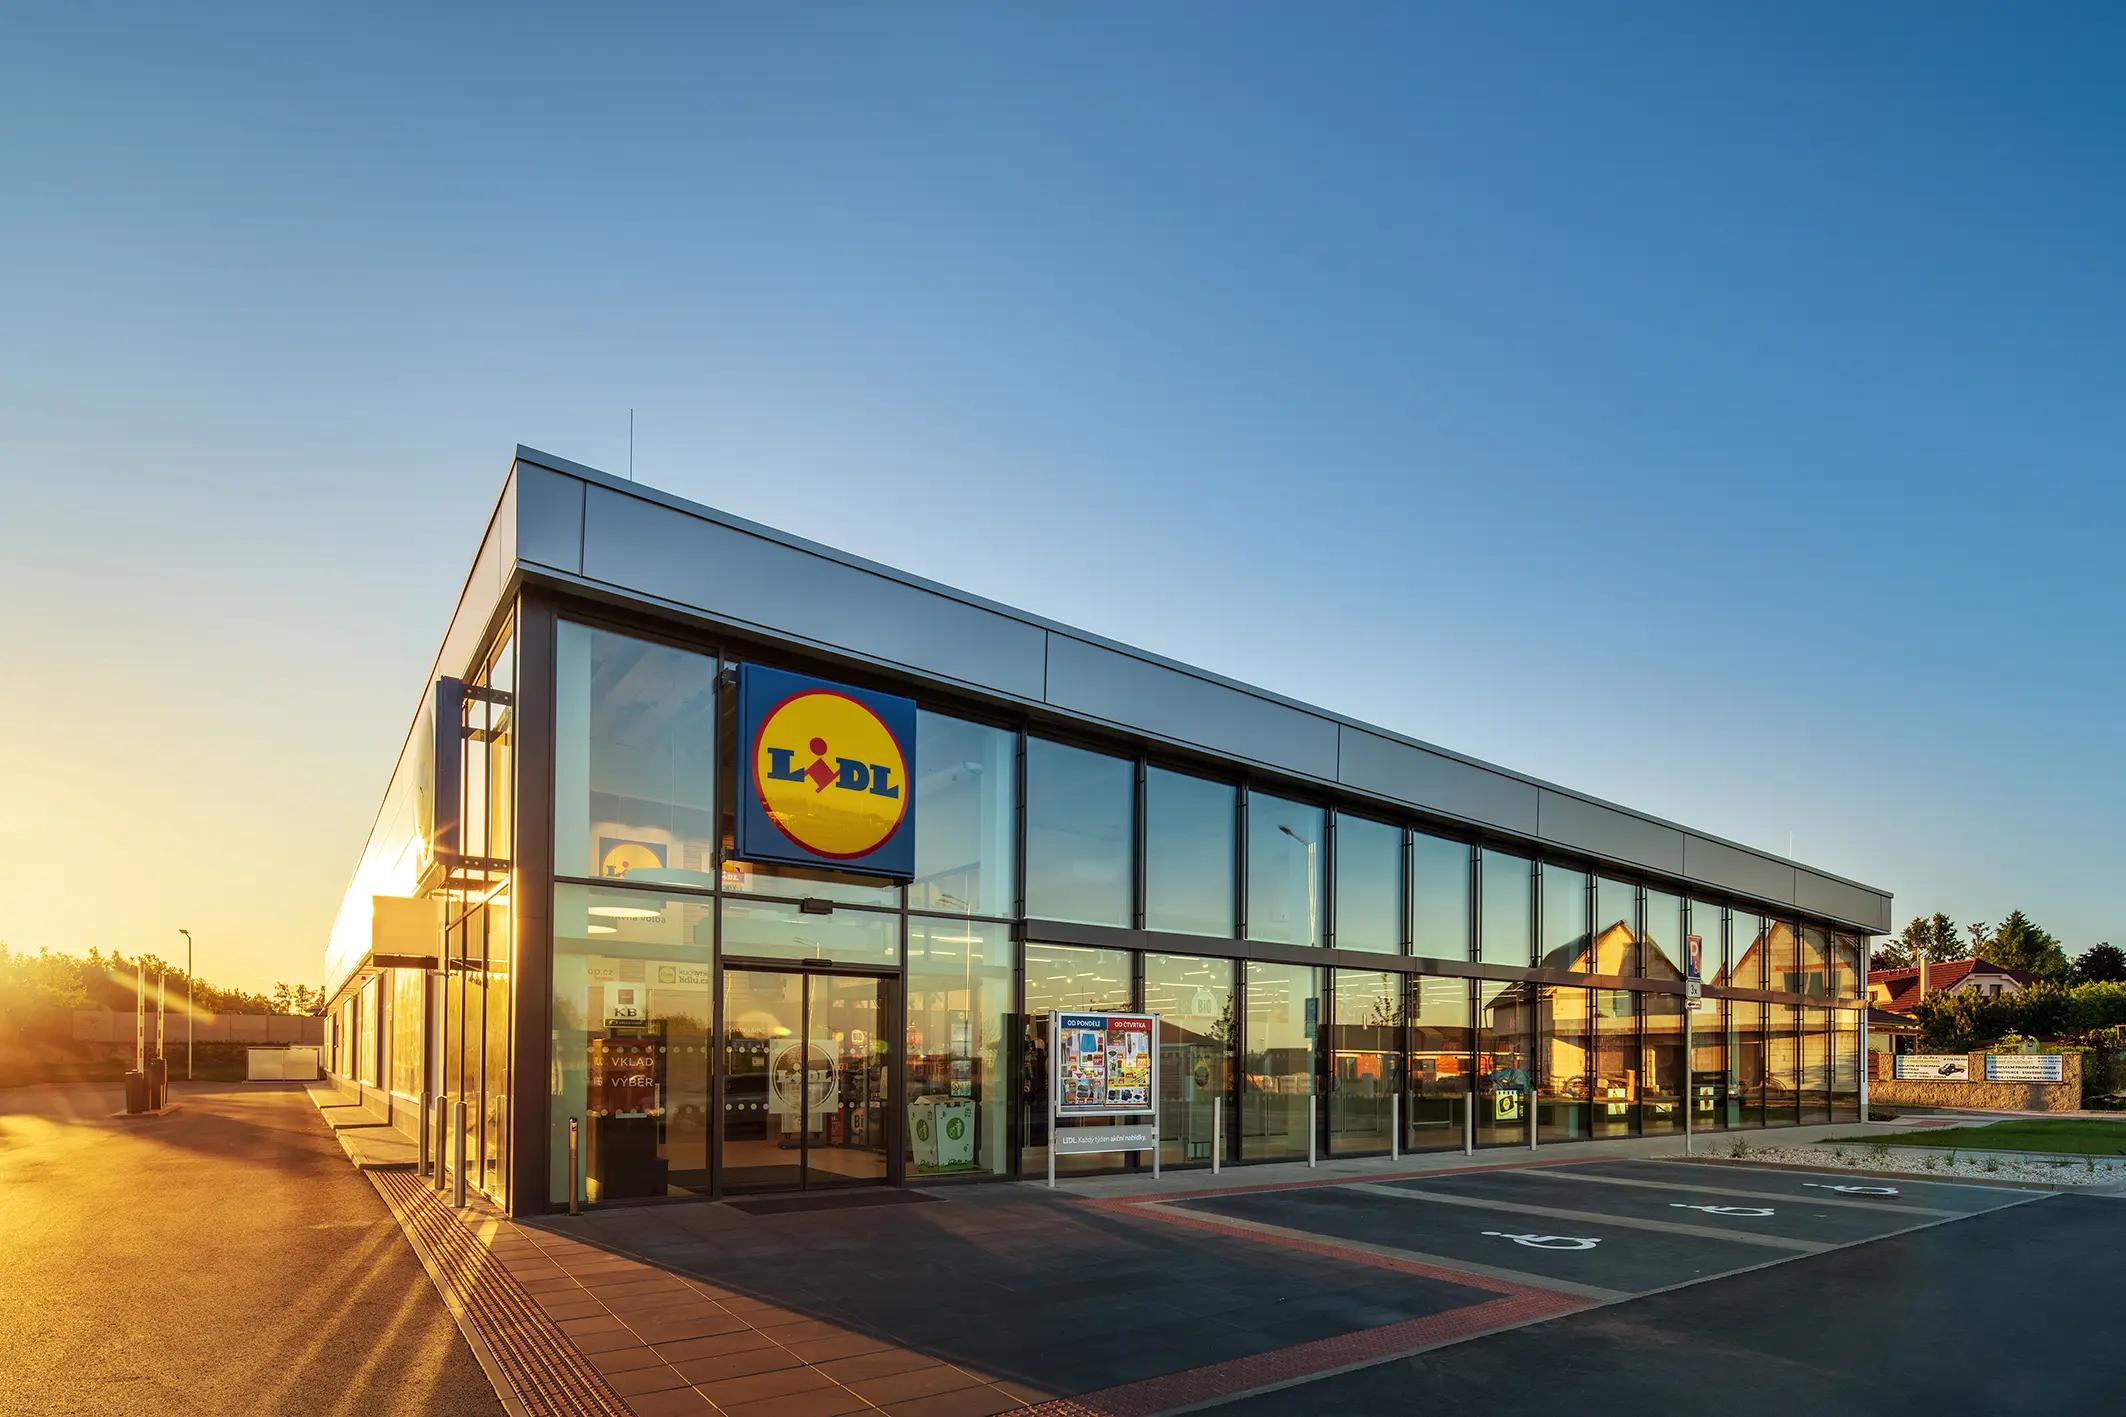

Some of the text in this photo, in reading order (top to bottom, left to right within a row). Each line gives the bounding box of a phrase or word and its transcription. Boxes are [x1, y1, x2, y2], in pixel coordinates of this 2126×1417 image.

[1690, 941, 1699, 966] P
[614, 1007, 638, 1017] KB
[611, 1056, 654, 1067] VKLAD
